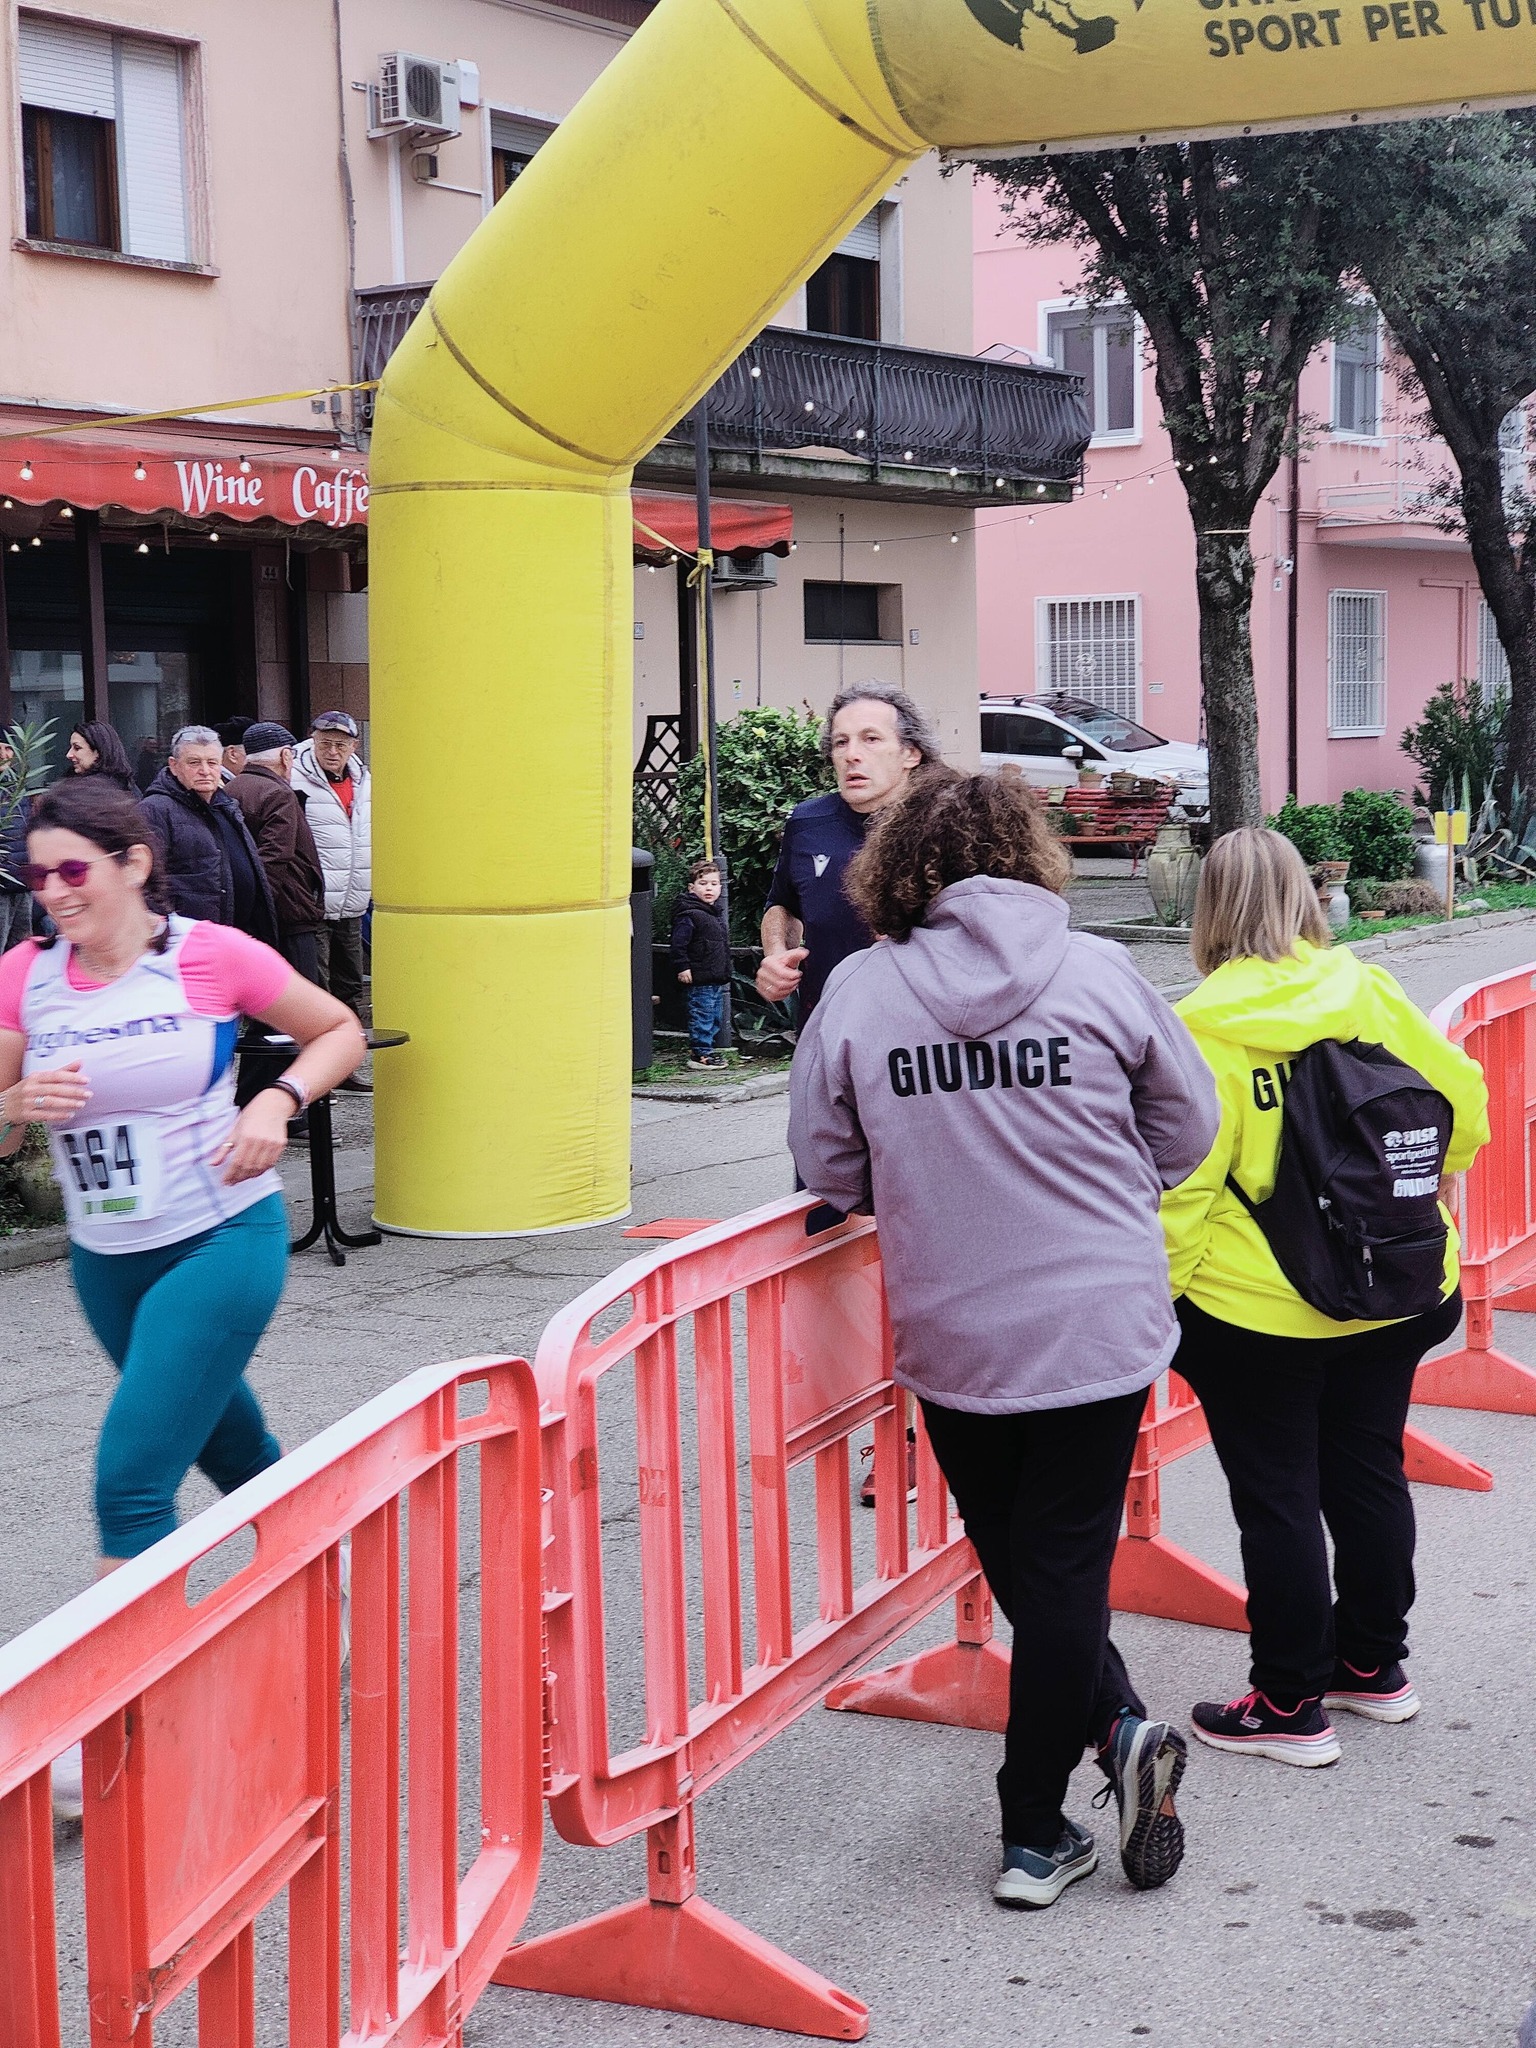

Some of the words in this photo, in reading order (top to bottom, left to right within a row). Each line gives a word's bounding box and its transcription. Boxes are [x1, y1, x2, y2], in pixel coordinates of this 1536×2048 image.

[1204, 9, 1341, 57] SPORT
[1363, 0, 1447, 42] PER
[174, 461, 264, 513] Wine
[292, 466, 369, 528] Caffè
[888, 1037, 1072, 1098] GIUDICE
